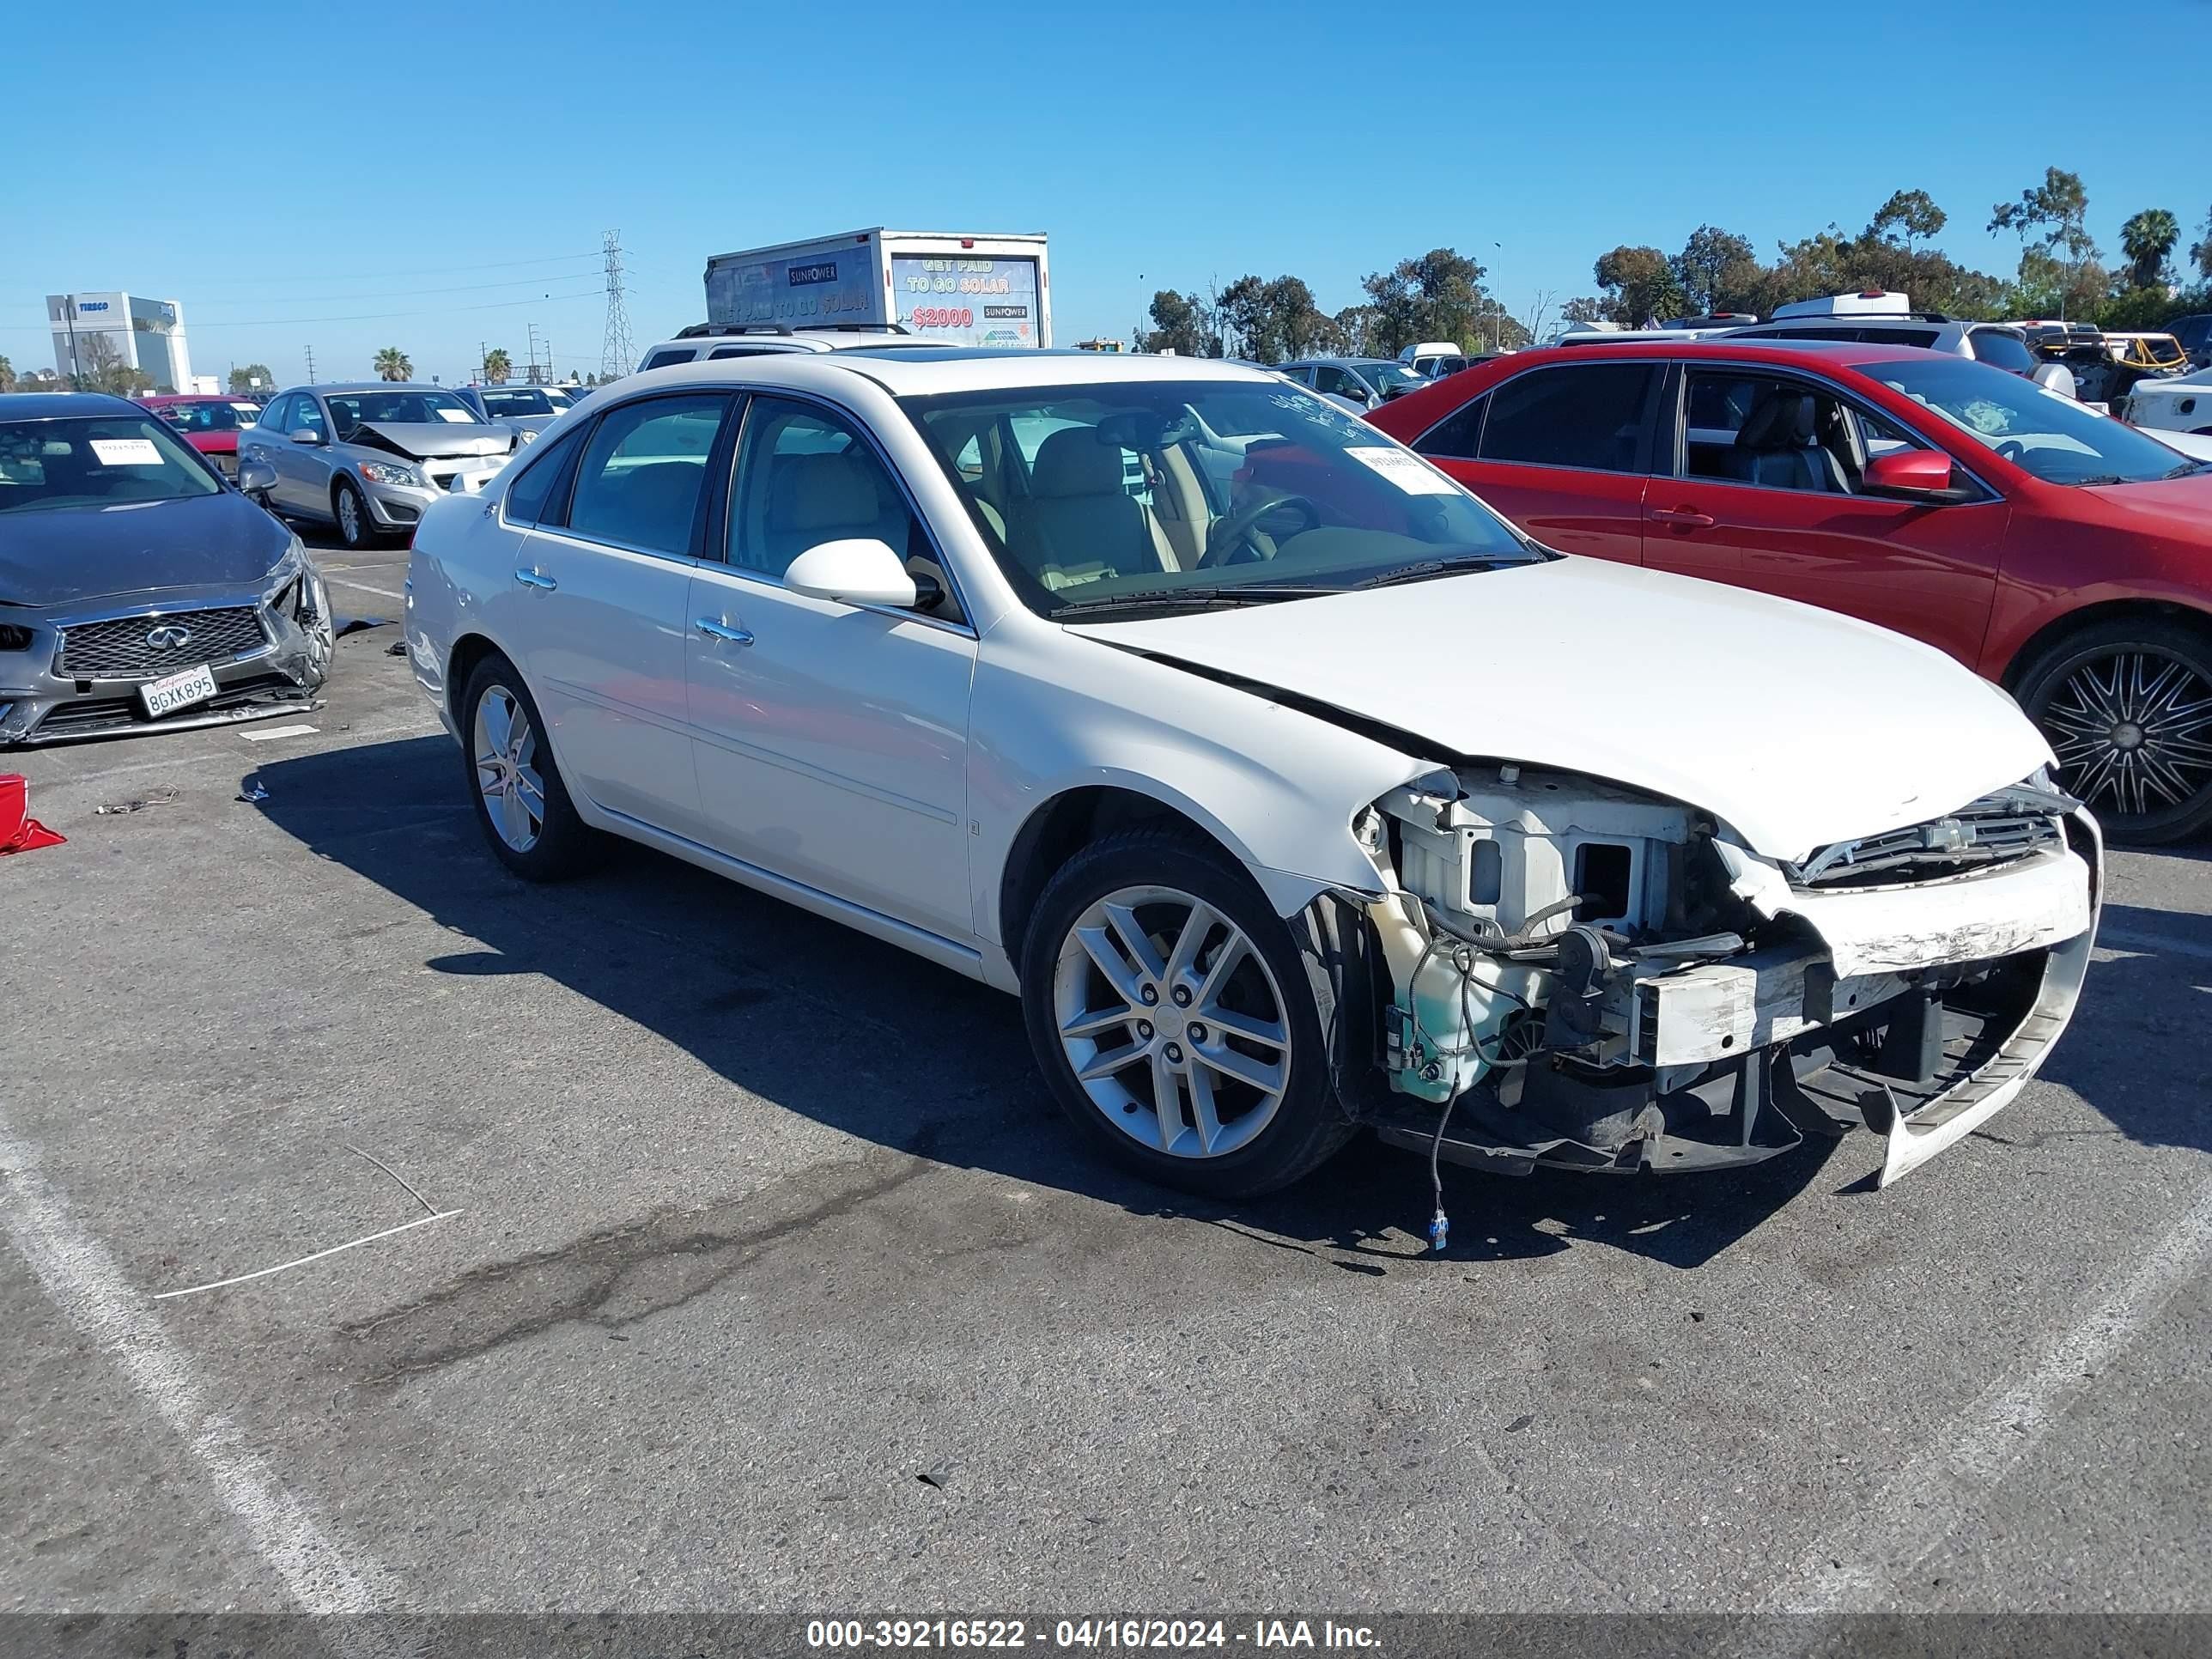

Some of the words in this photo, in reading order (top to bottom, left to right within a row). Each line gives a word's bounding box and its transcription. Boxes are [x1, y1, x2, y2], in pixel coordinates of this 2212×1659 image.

[790, 265, 836, 283] SUNPOWER
[922, 259, 952, 272] GET
[957, 259, 994, 273] PAID
[907, 276, 930, 293] TO
[933, 276, 957, 293] GO
[960, 277, 1011, 295] SOLAR
[79, 301, 109, 312] TIRECO
[986, 307, 1026, 317] SUNPOWER
[913, 306, 974, 331] $2000
[156, 672, 198, 690] California
[149, 676, 213, 711] 8GXK895
